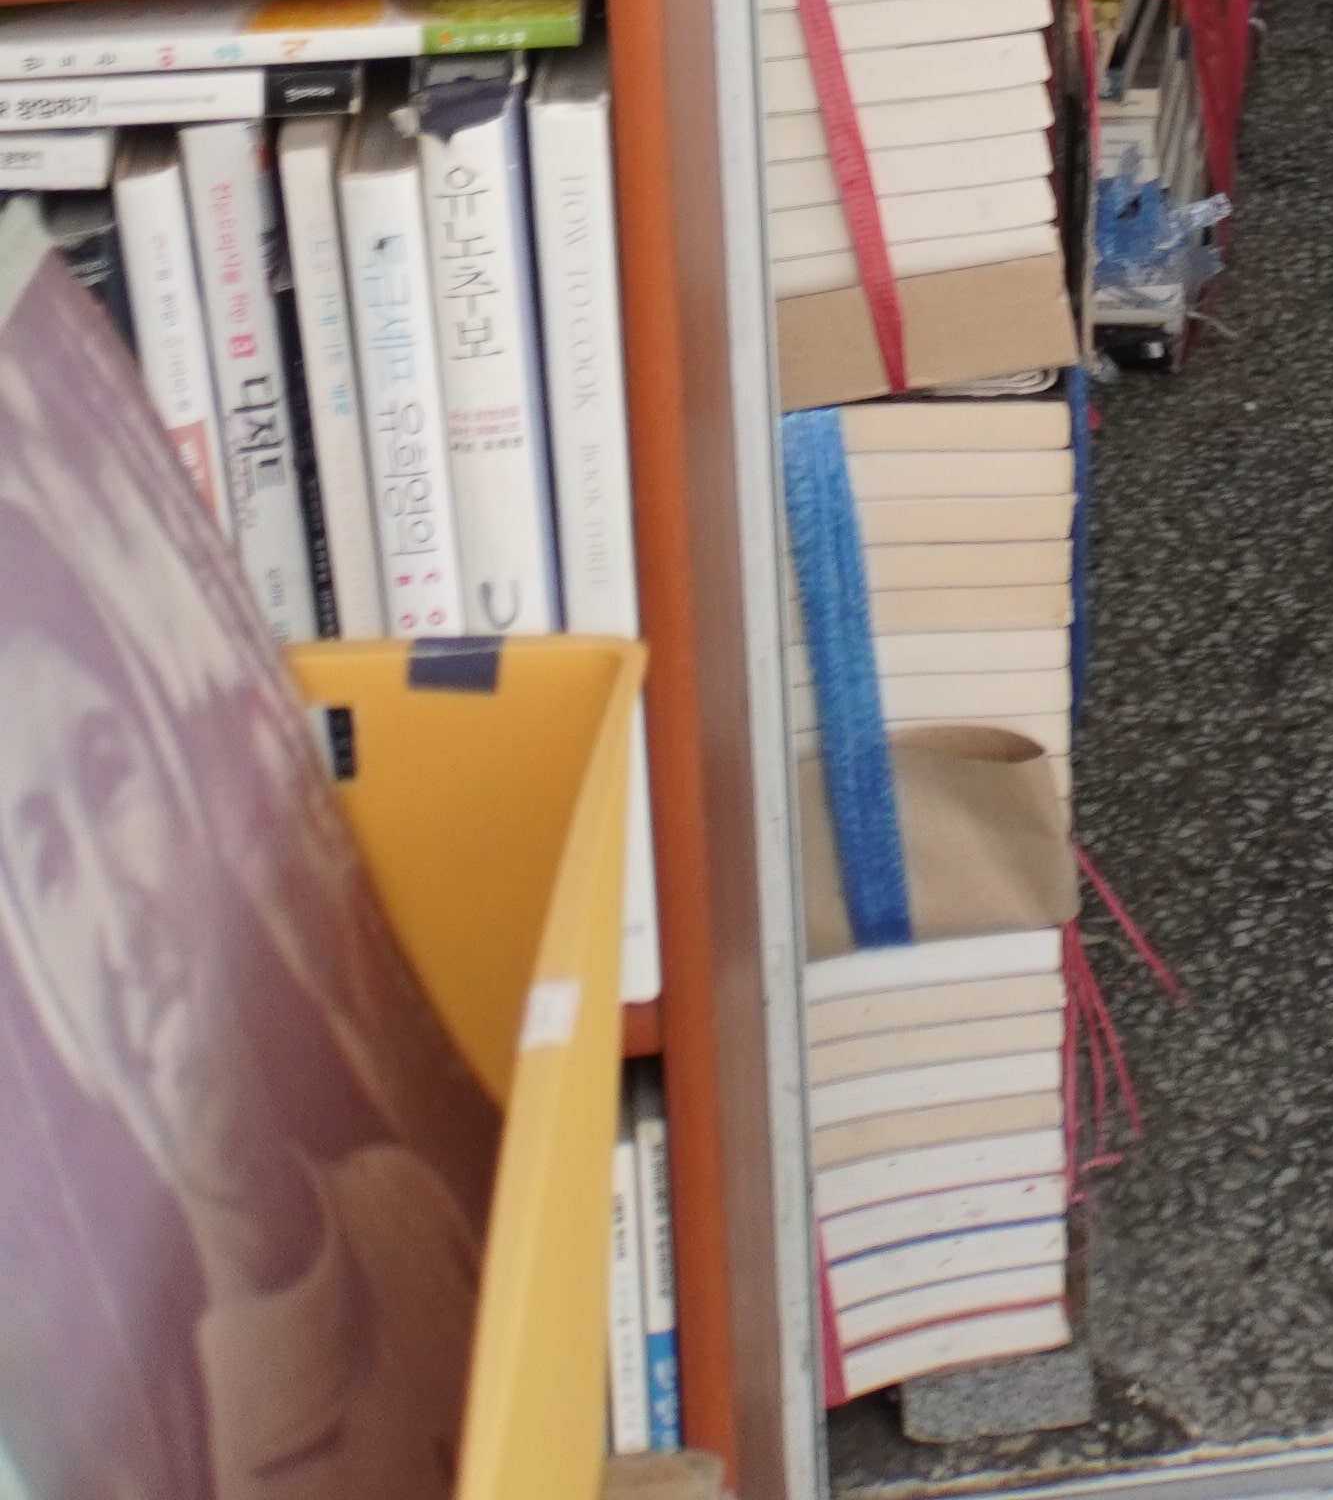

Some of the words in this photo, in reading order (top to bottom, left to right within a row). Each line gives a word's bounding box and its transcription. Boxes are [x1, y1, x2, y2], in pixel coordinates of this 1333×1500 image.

[560, 171, 588, 246] HOW
[563, 264, 590, 307] TO
[566, 314, 602, 411] COOK
